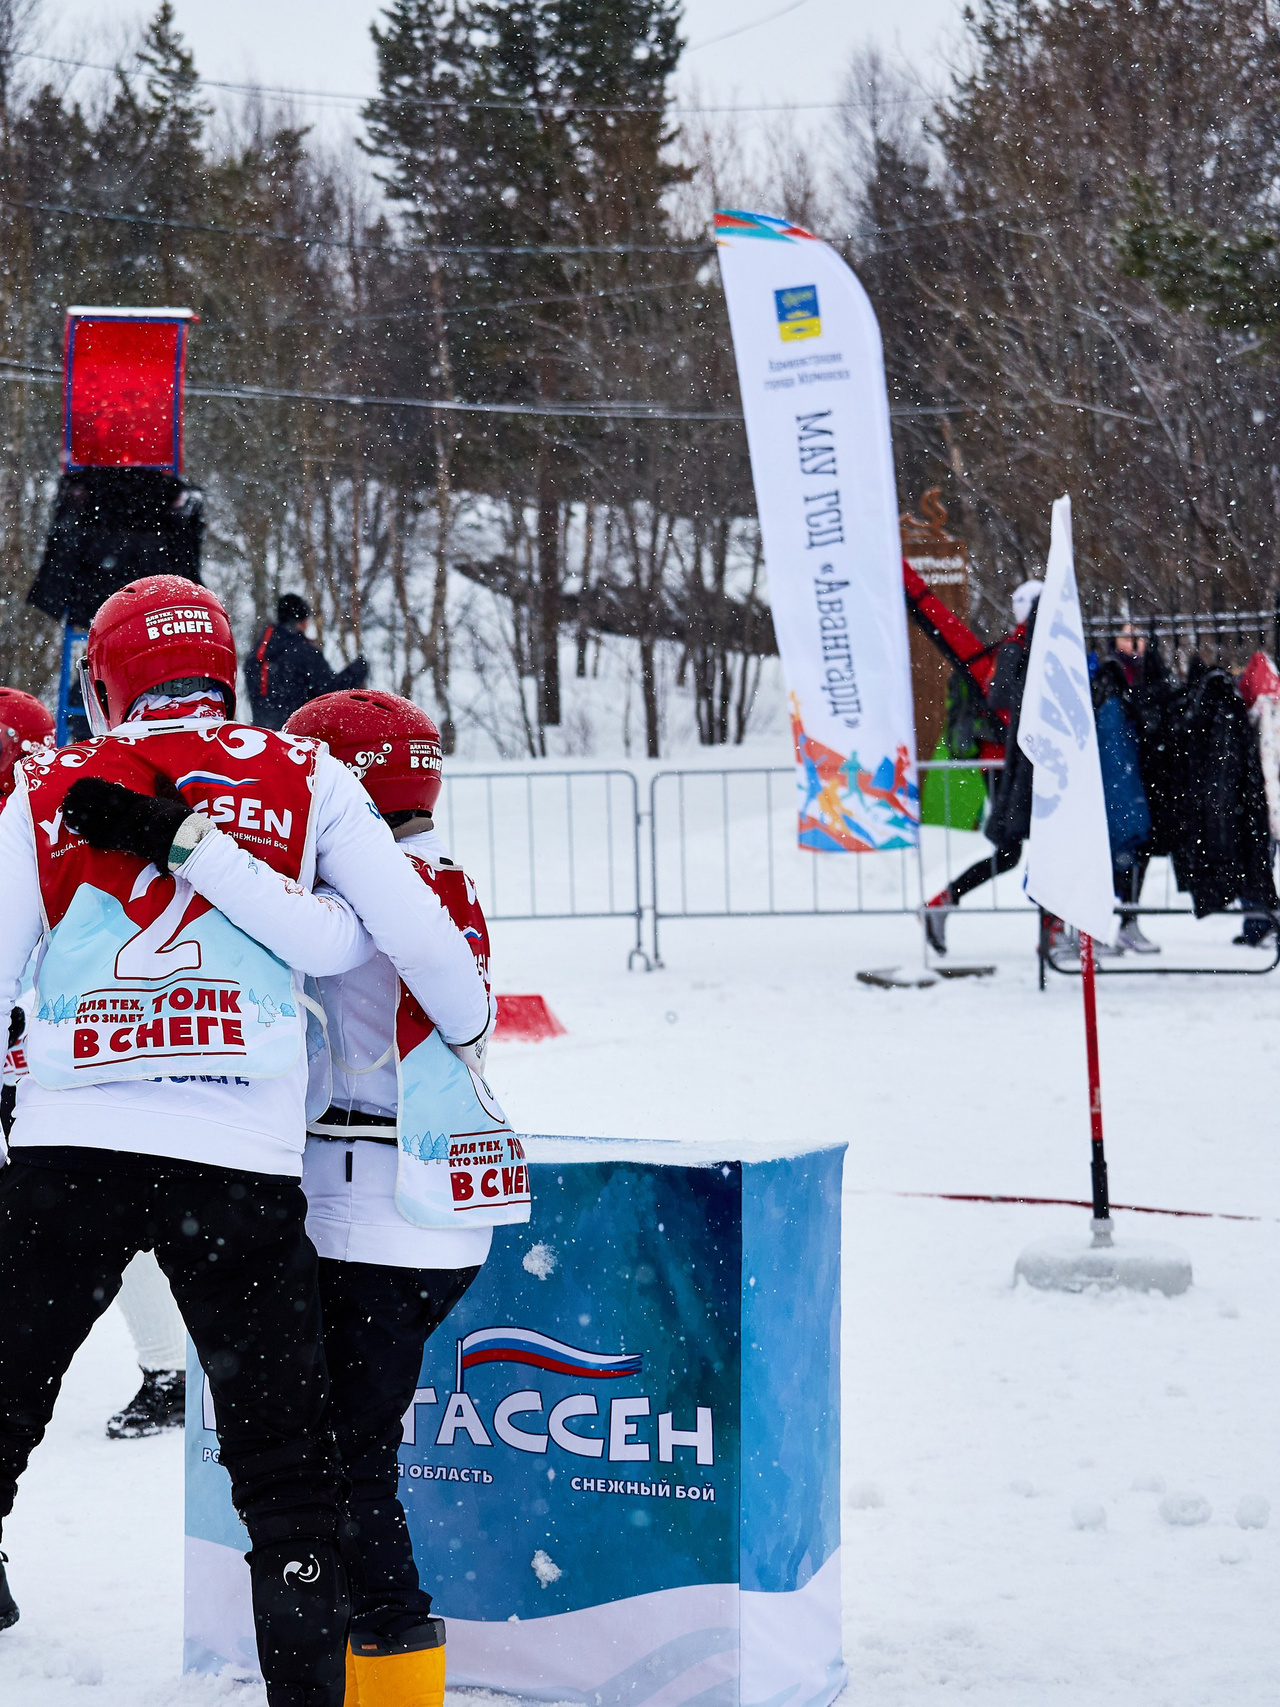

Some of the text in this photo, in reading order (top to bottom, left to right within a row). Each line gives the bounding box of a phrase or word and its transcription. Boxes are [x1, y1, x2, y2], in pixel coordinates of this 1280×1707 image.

[795, 410, 862, 729] МАУ ГСЦ «Авангард»
[174, 609, 210, 621] ТОЛК
[147, 620, 214, 640] В СНЕГЕ
[410, 755, 420, 768] В
[227, 831, 272, 846] СНЕЖНЫЙ
[114, 861, 202, 980] 2
[77, 998, 145, 1014] ДЛЯ ТЕХ,
[152, 987, 242, 1014] ТОЛК
[75, 1013, 144, 1025] КТО ЗНАЕТ
[73, 1016, 245, 1058] В СНЕГЕ
[449, 1139, 504, 1157] ДЛЯ ТЕХ,
[449, 1153, 504, 1167] КТО ЗНАЕТ
[450, 1171, 474, 1201] В
[408, 1463, 494, 1484] ОБЛАСТЬ
[570, 1476, 716, 1501] СНЕЖНЫЙ БОЙ
